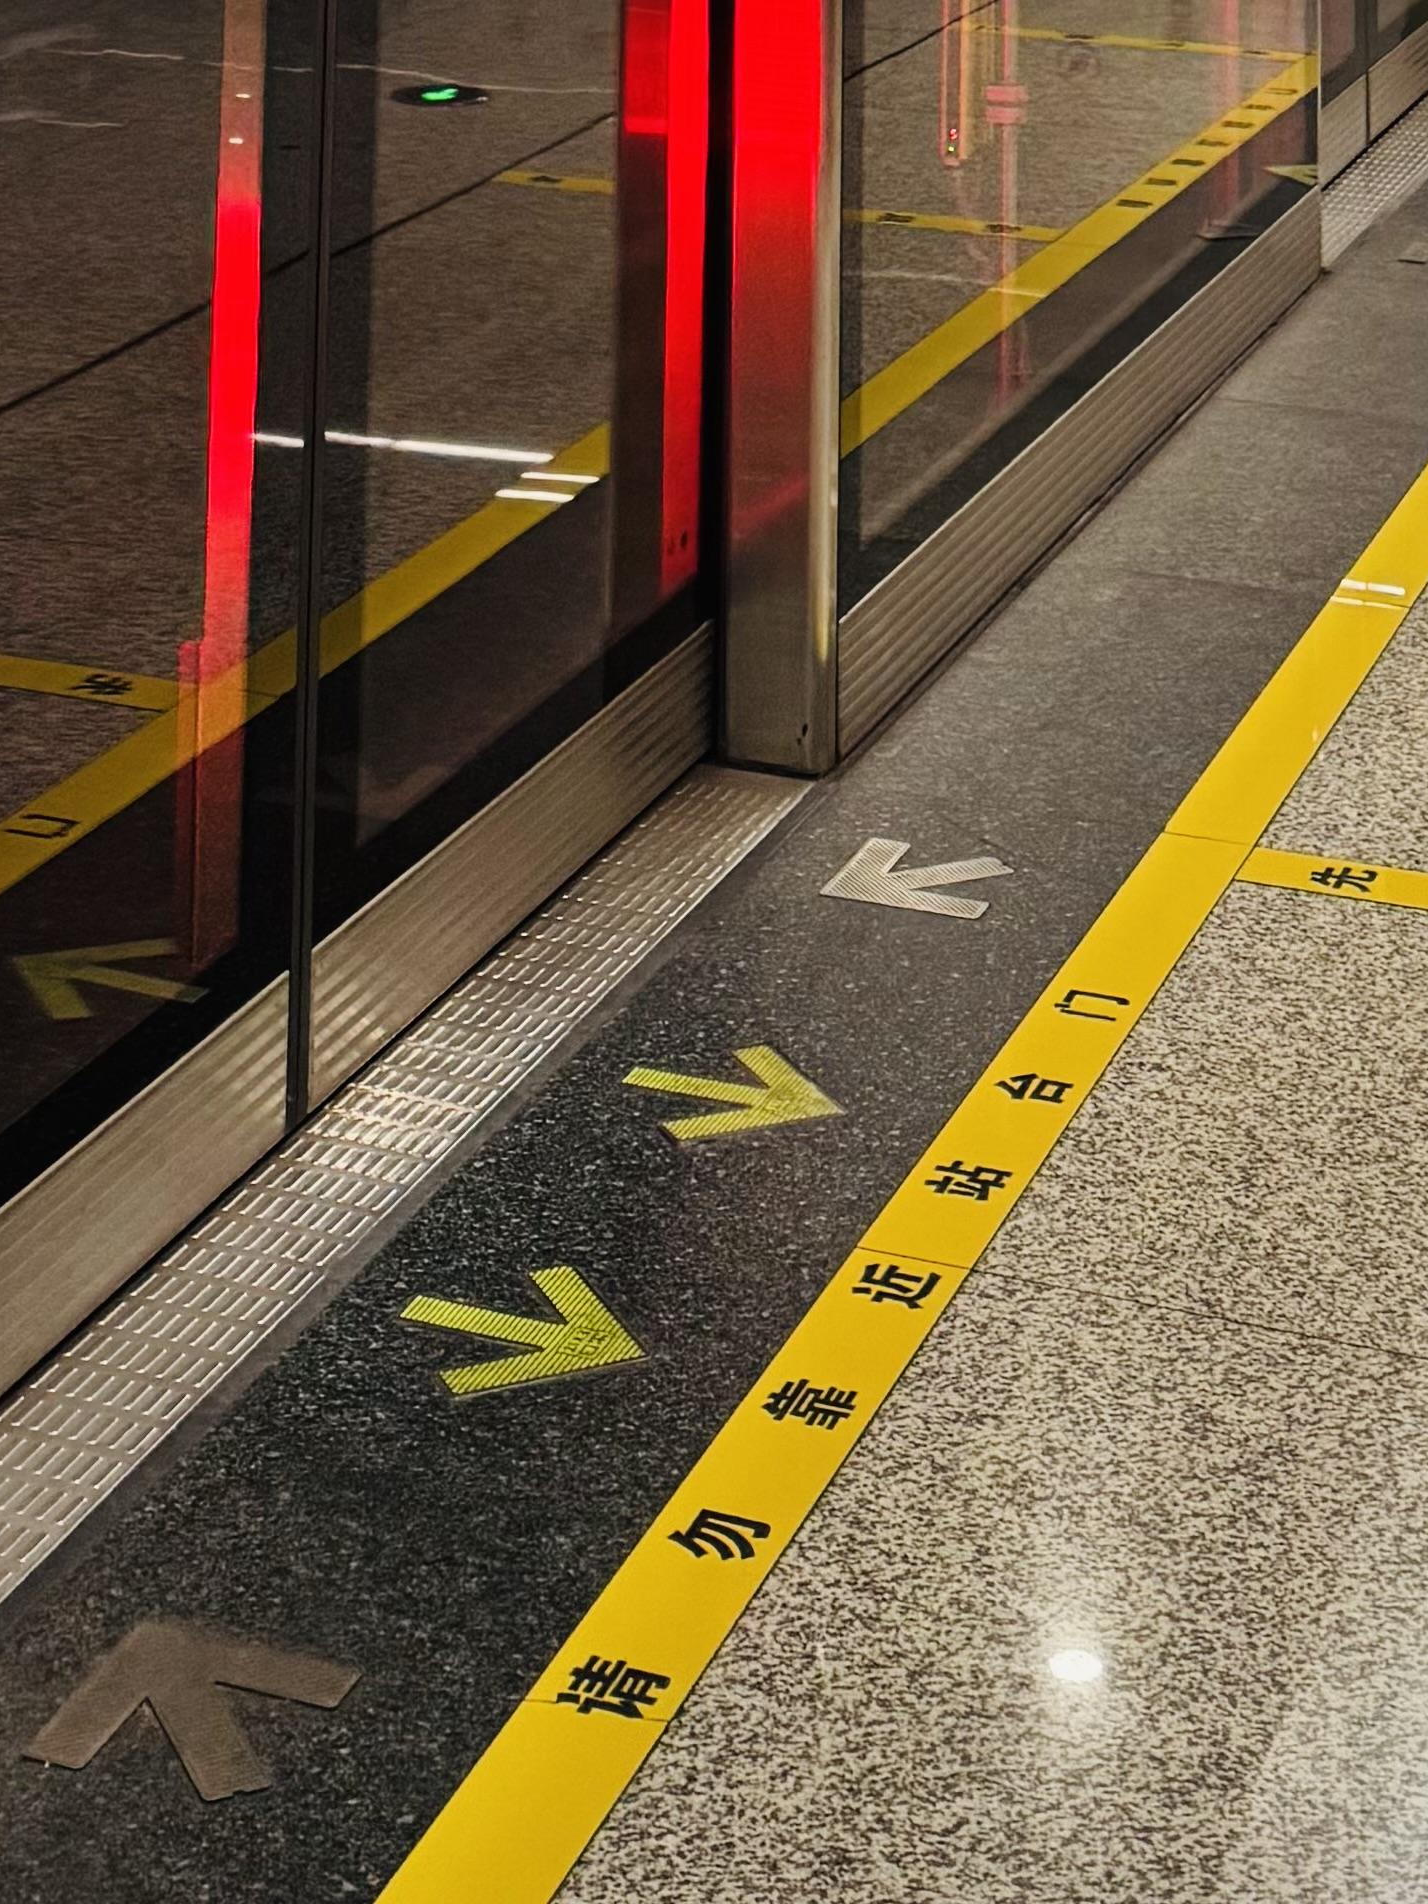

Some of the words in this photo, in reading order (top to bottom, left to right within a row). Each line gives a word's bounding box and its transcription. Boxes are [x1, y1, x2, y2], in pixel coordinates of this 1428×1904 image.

[555, 987, 1131, 1722] 请勿靠近站台门
